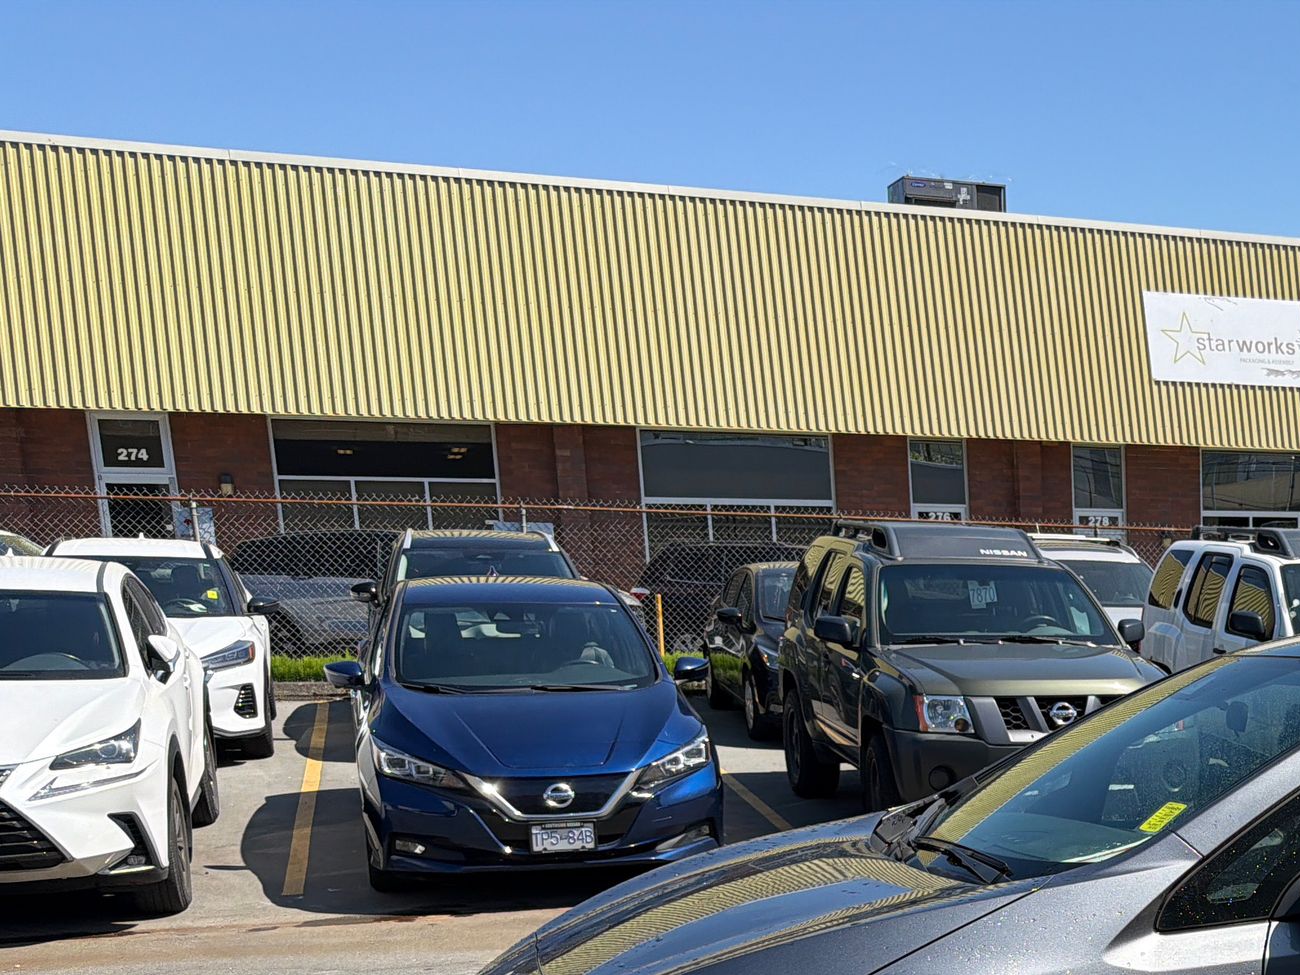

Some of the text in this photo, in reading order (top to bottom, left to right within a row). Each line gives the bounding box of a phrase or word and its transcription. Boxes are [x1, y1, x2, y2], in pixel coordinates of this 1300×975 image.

[1196, 333, 1296, 356] starworks
[117, 448, 149, 461] 274
[928, 512, 951, 521] 276
[1088, 516, 1110, 526] 278
[979, 548, 1028, 557] NISSAN
[969, 586, 996, 603] 7870
